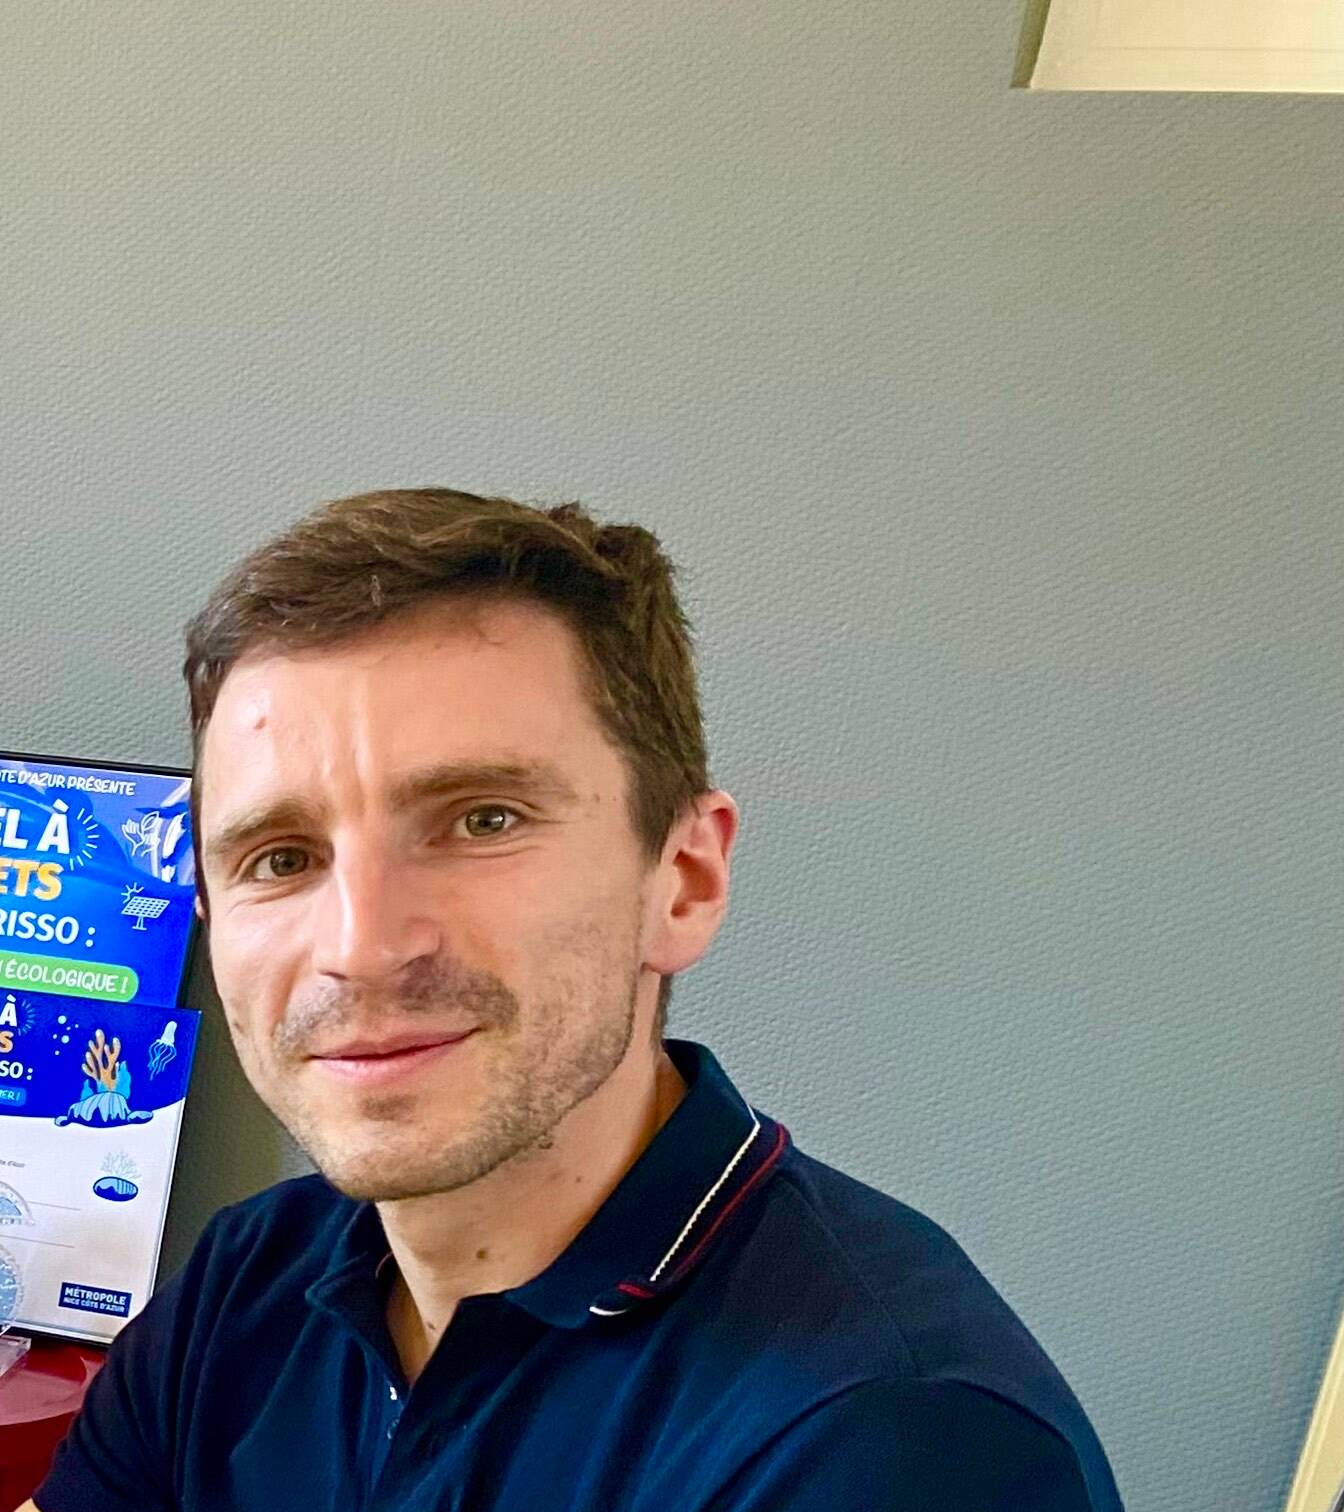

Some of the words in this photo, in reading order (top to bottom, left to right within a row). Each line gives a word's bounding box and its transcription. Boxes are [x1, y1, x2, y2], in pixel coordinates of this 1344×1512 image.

[18, 770, 66, 789] D'AZUR
[67, 776, 137, 797] PRÉSENTE
[36, 797, 71, 855] À
[5, 958, 118, 994] ÉCOLOGIQUE
[64, 1286, 127, 1306] MÉTROPOLE
